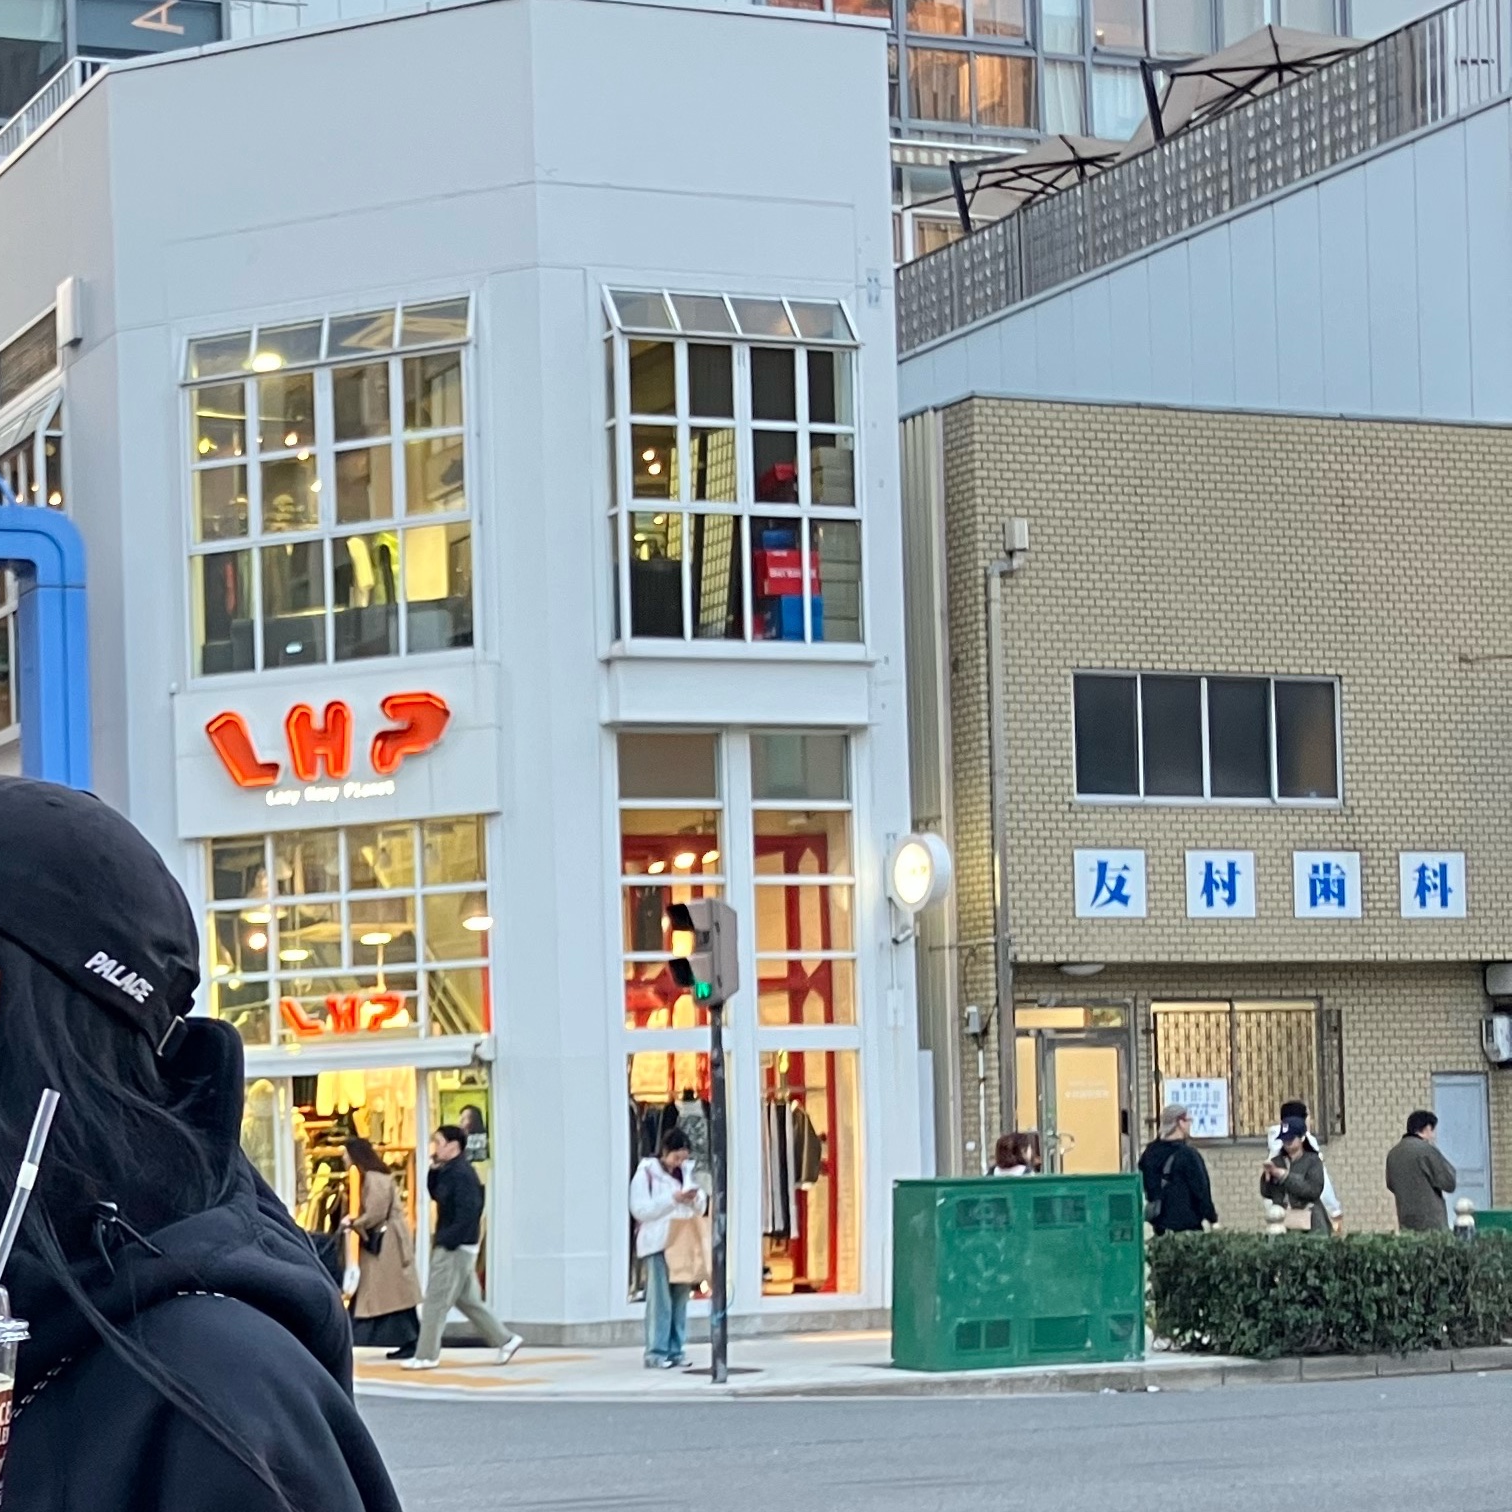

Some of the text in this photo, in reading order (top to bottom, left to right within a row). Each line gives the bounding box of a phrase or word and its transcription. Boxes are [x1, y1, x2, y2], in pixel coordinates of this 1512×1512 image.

[205, 692, 450, 788] LHP
[1090, 859, 1453, 909] 友村歯科
[84, 951, 154, 1004] PALACE
